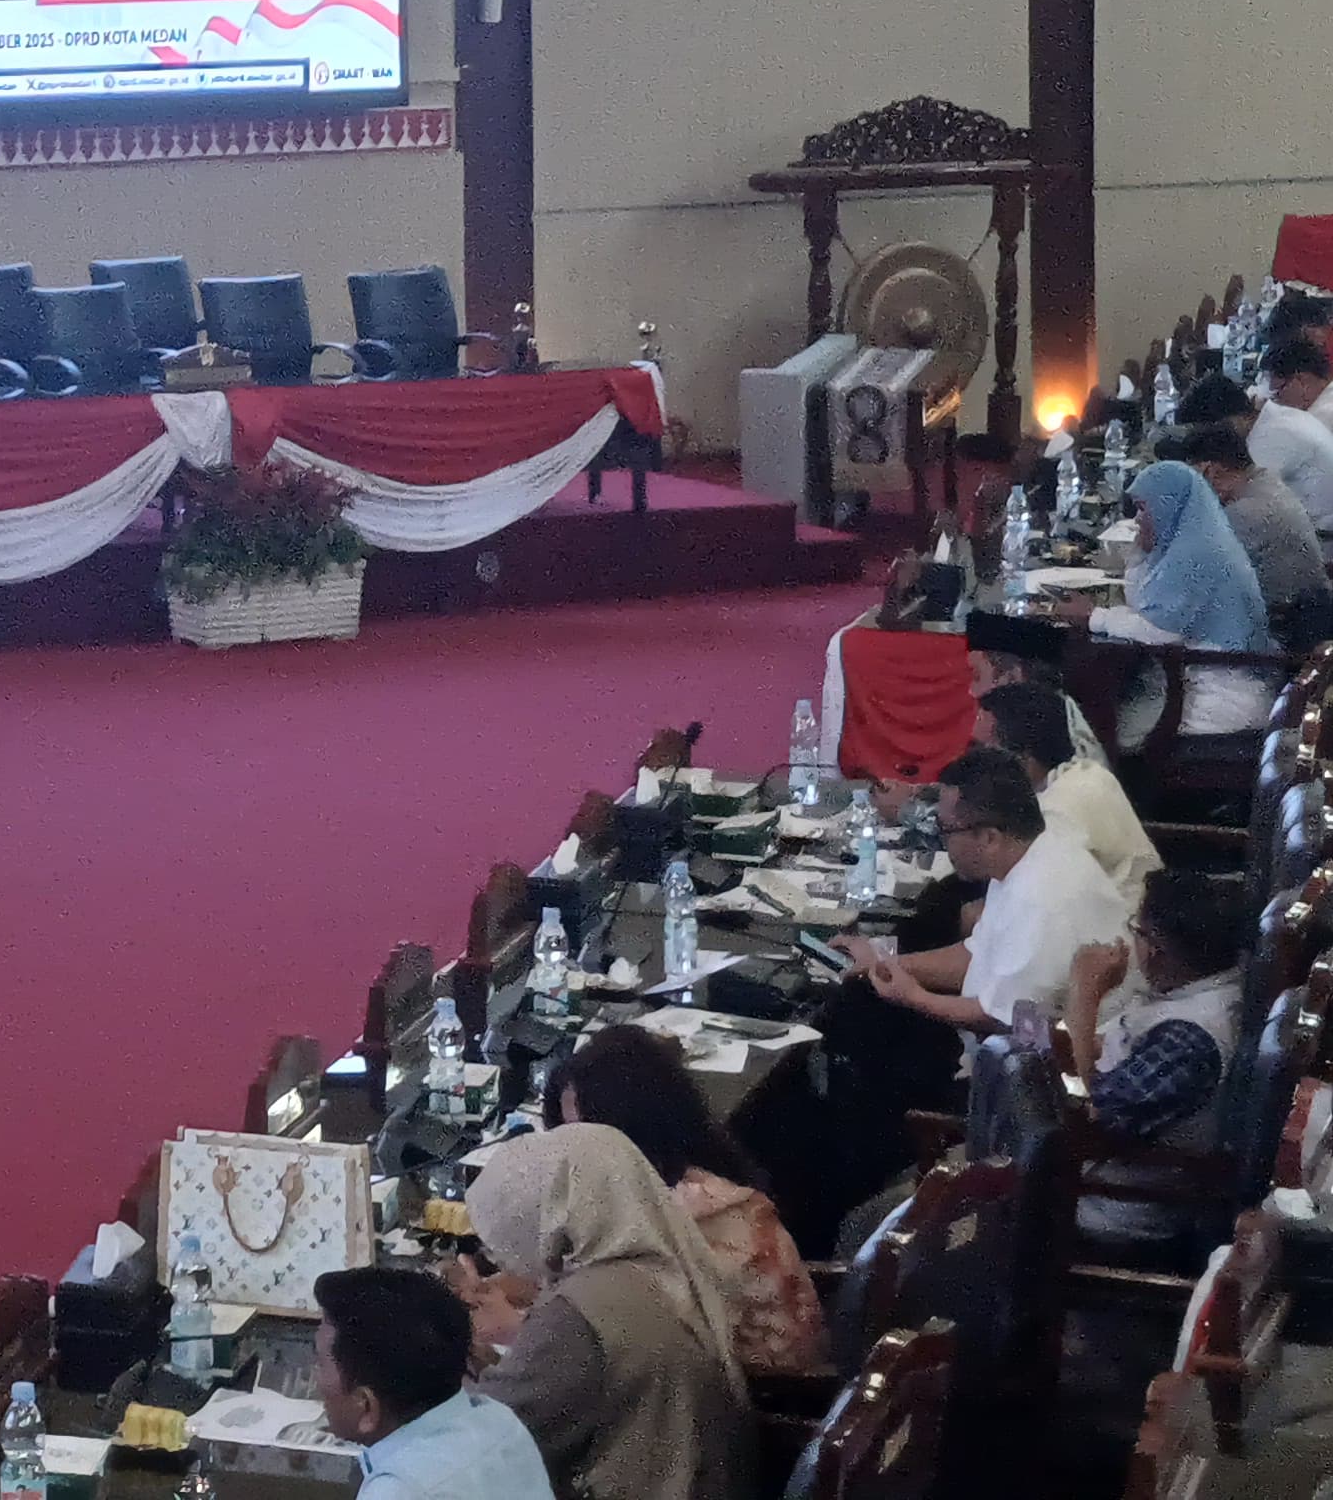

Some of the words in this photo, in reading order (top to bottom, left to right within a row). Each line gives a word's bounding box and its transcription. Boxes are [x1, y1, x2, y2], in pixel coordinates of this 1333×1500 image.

[25, 33, 55, 49] 2025
[64, 31, 100, 47] DPRD
[103, 30, 137, 46] KOTA
[141, 28, 187, 45] MEDAN
